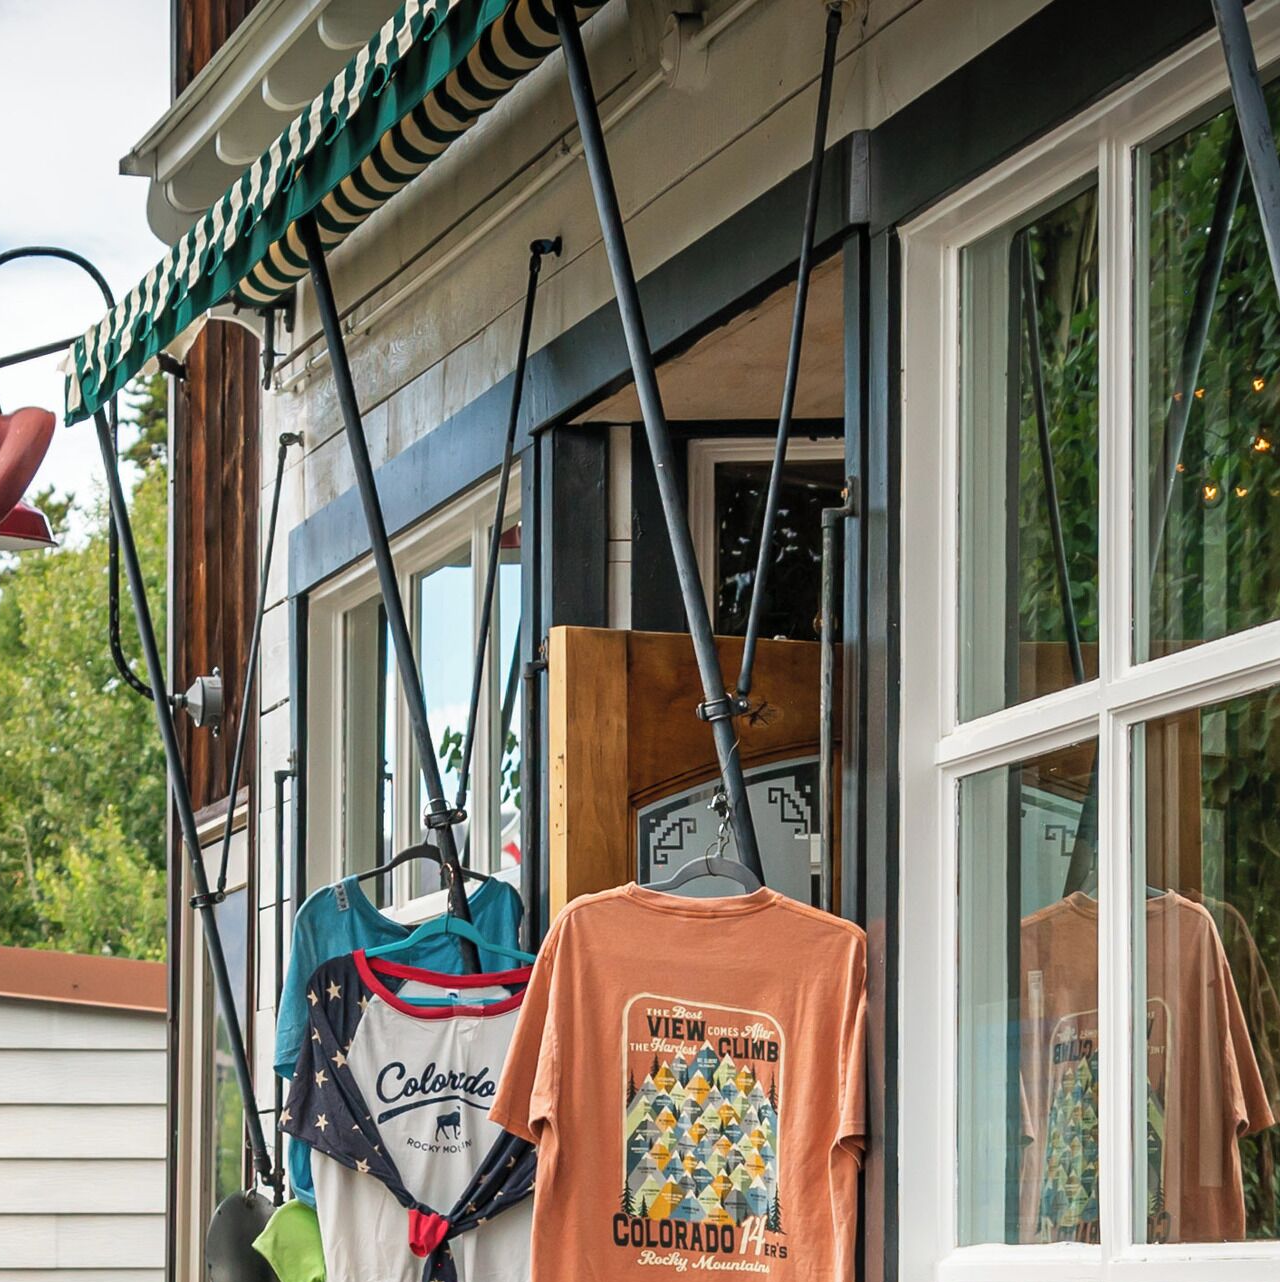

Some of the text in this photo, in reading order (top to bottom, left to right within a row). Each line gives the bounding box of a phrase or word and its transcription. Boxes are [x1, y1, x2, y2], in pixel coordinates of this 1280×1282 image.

[646, 1005, 703, 1019] THE Best
[646, 1015, 776, 1044] VIEW COMES After
[629, 1037, 779, 1063] THE Hardest CLIMB
[406, 1137, 440, 1154] ROCKY
[613, 1213, 735, 1254] COLORADO
[637, 1250, 770, 1274] Rocky Mountains
